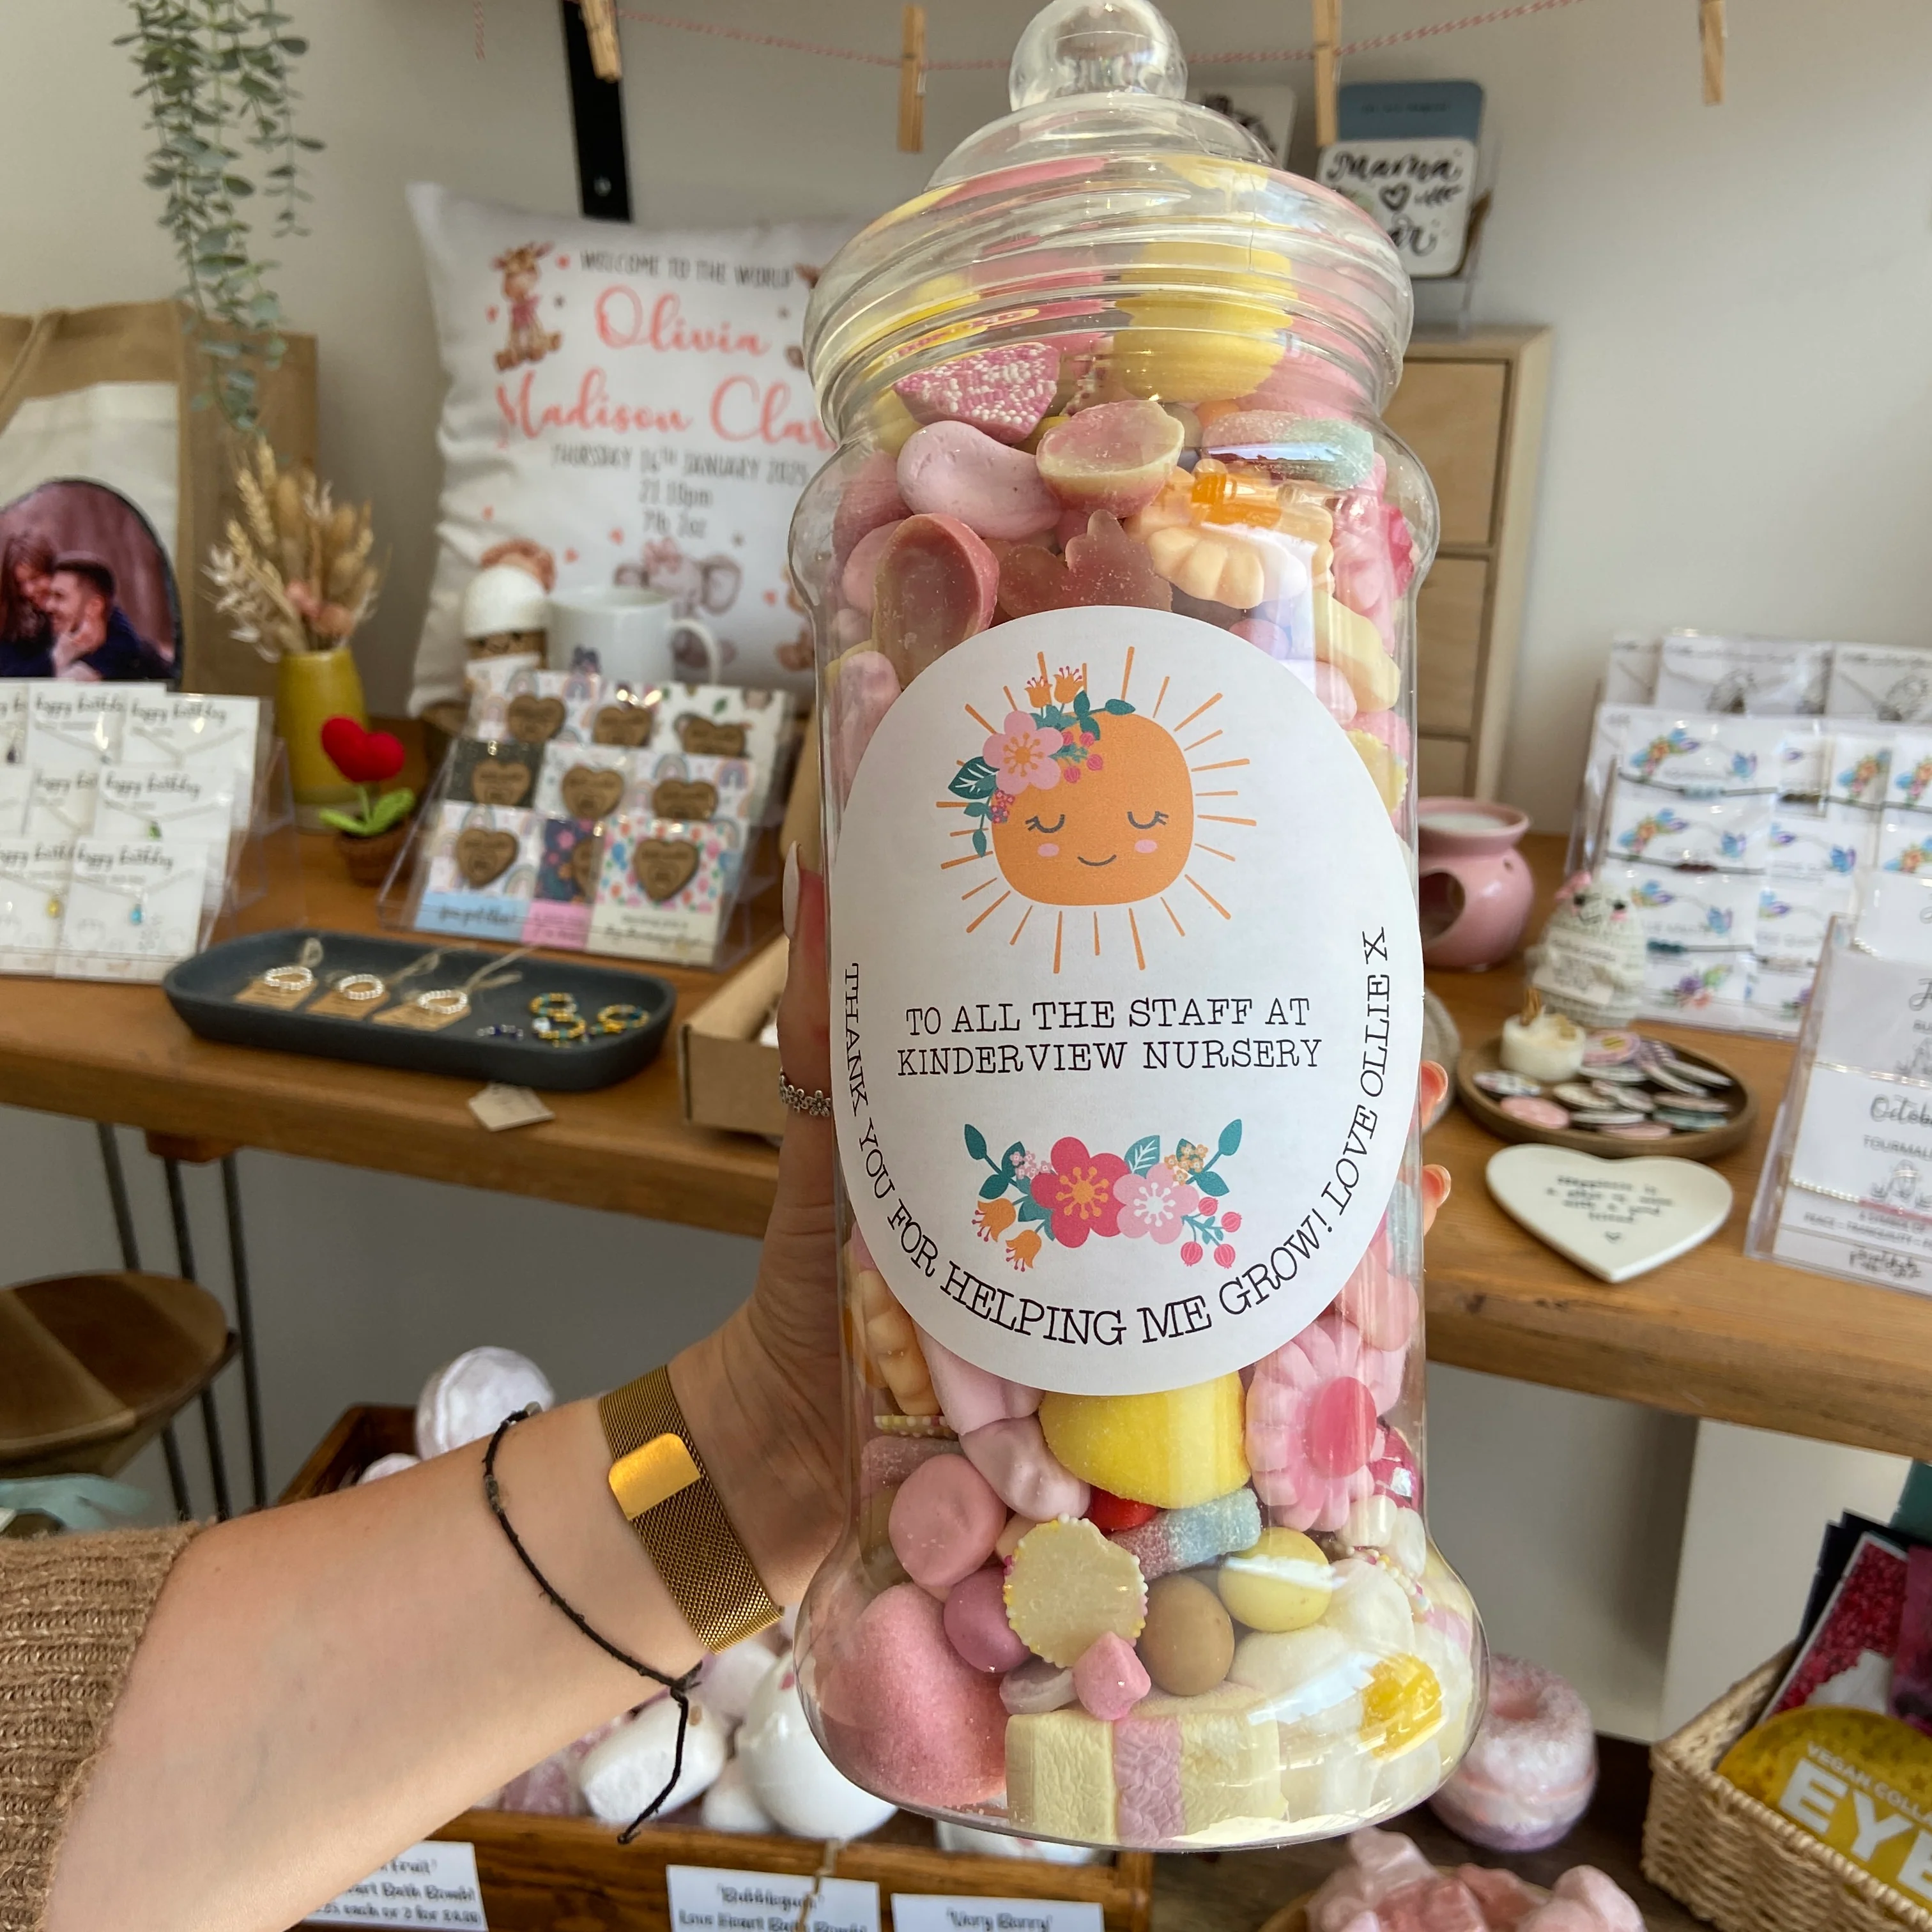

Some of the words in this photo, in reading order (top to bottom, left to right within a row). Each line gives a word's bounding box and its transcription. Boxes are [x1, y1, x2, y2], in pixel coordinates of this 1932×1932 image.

[579, 250, 659, 279] WELCOME
[668, 257, 691, 281] TO
[696, 259, 726, 286] THE
[735, 264, 792, 290] WORLD
[594, 283, 771, 358] Olivia
[551, 445, 632, 470] THURSDAY
[682, 450, 760, 480] JANUARY
[1362, 926, 1388, 965] X
[845, 962, 869, 1117] THANK
[905, 1006, 941, 1036] TO
[951, 1003, 1020, 1033] ALL
[1032, 1000, 1115, 1031] THE
[1129, 997, 1252, 1027] STAFF
[1265, 997, 1310, 1025] AT
[1360, 974, 1390, 1097] OLLIE
[897, 1041, 1128, 1077] KINDERVIEW
[1142, 1038, 1322, 1070] NURSERY
[859, 1116, 896, 1199] YOU
[1321, 1104, 1378, 1216] LOVE
[887, 1199, 939, 1278] FOR
[1219, 1208, 1333, 1315] GROW!
[939, 1260, 1127, 1346] HELPING
[1136, 1295, 1212, 1344] ME
[1807, 1740, 1872, 1789] VEGAN
[678, 1908, 713, 1927] Love
